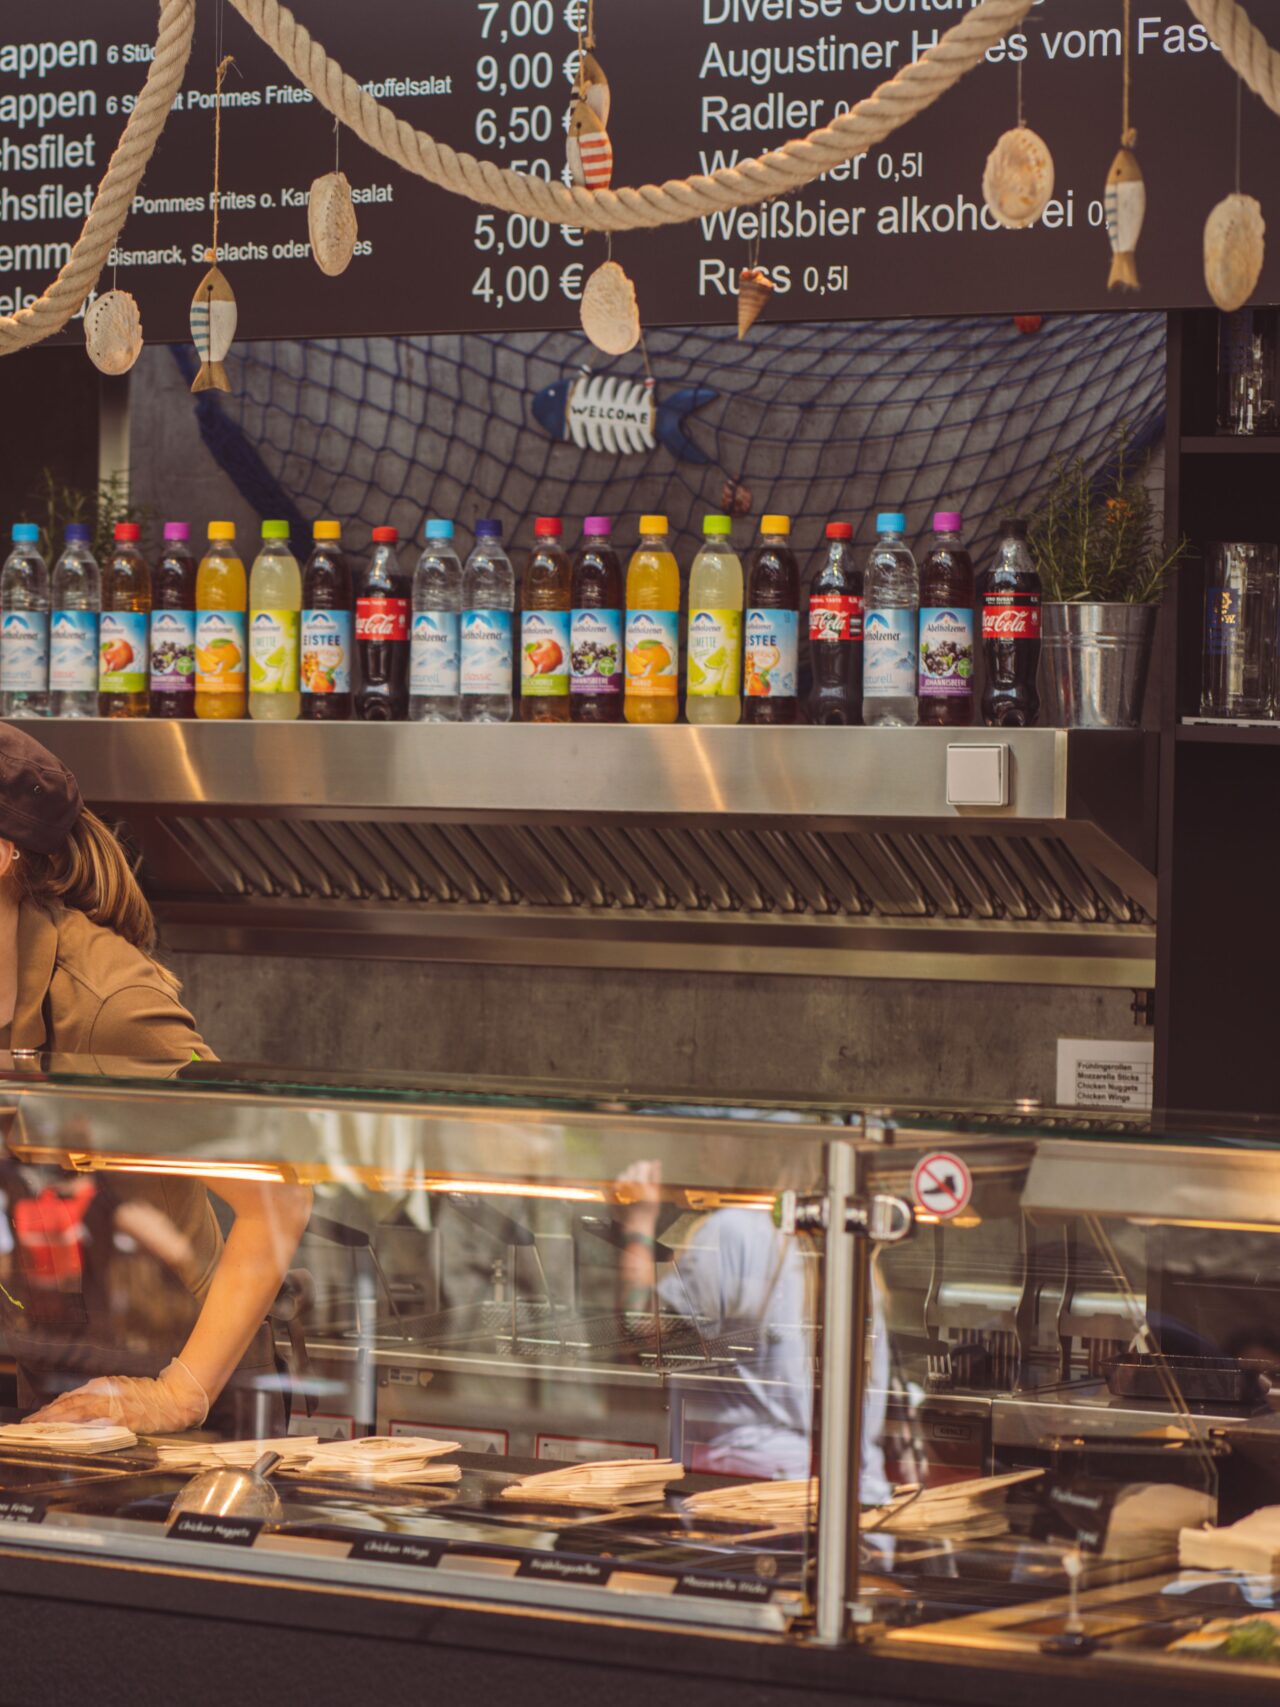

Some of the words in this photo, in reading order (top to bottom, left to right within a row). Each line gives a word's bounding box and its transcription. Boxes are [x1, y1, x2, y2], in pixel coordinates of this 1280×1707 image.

[477, 0, 554, 43] 7,00
[106, 45, 118, 64] 6
[699, 35, 899, 84] Augustiner
[1041, 27, 1122, 59] vom
[476, 52, 553, 96] 9,00
[106, 96, 118, 115] 6
[187, 90, 261, 110] Pommes
[265, 84, 313, 104] Frites
[701, 92, 824, 133] Radler
[475, 104, 552, 150] 6,50
[877, 152, 923, 182] 0,5l
[132, 195, 205, 214] Pommes
[209, 191, 256, 211] Frites
[701, 199, 865, 241] Weißbier
[473, 213, 550, 255] 5,00
[107, 245, 187, 267] Bismarck,
[272, 240, 311, 259] oder
[471, 263, 549, 309] 4,00
[559, 262, 585, 300] €
[803, 265, 849, 295] 0,5l
[571, 405, 649, 424] WELCOME
[303, 634, 341, 646] EISTEE
